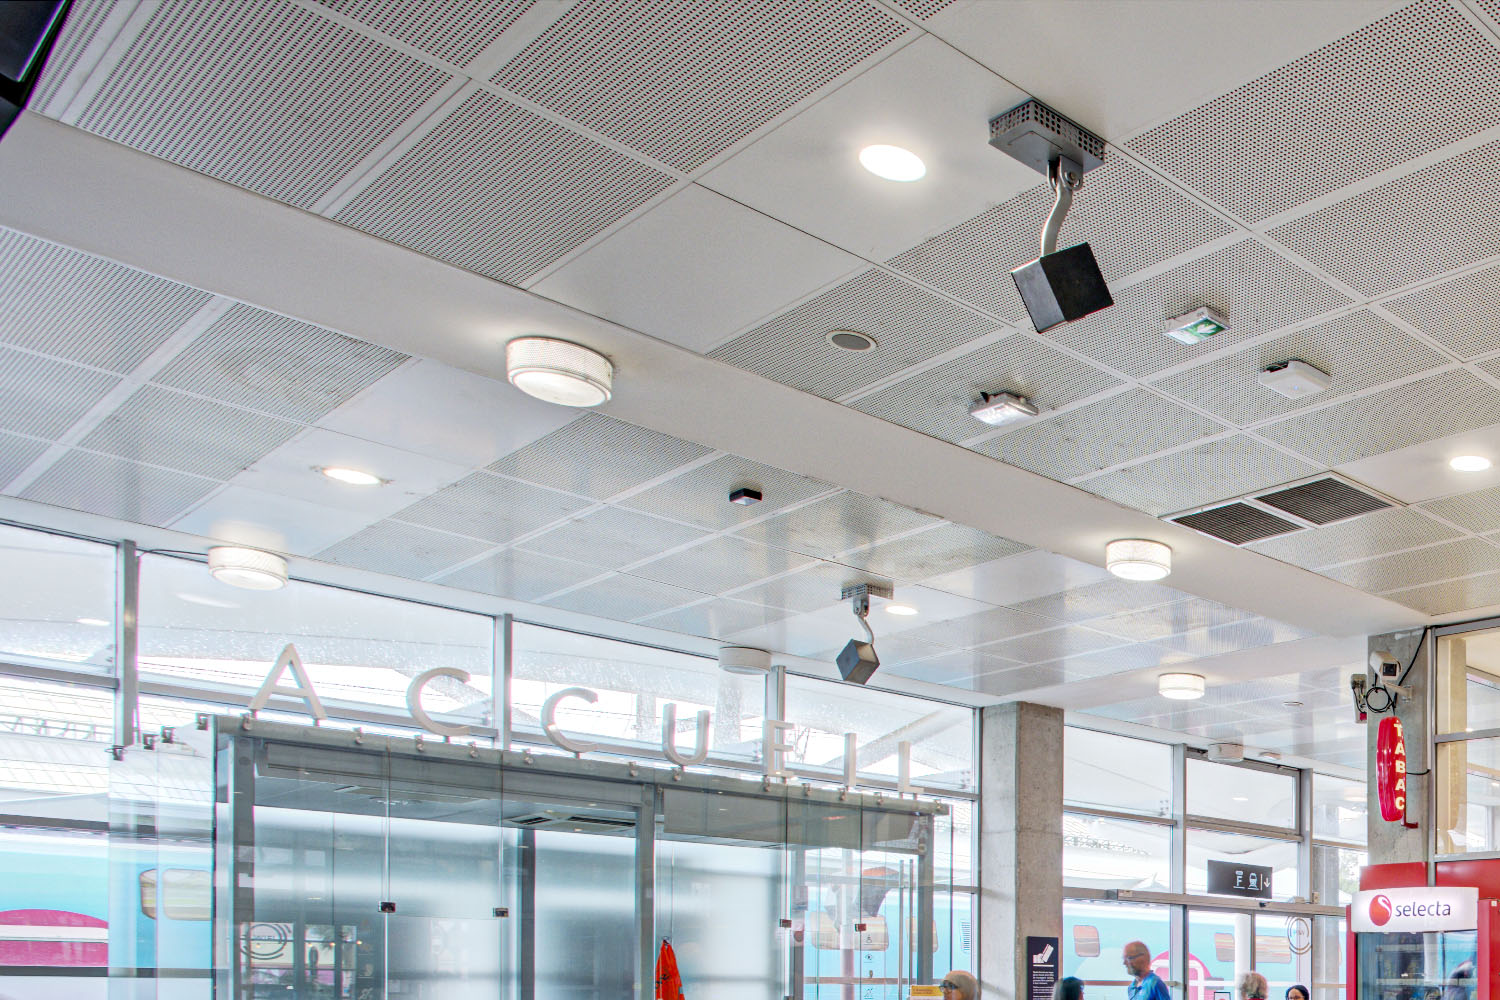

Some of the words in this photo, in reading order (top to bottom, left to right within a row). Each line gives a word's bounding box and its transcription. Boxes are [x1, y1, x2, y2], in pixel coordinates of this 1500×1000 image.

[250, 643, 923, 794] ACCUEIL
[1393, 723, 1406, 811] TABAC
[1395, 901, 1451, 917] selecta
